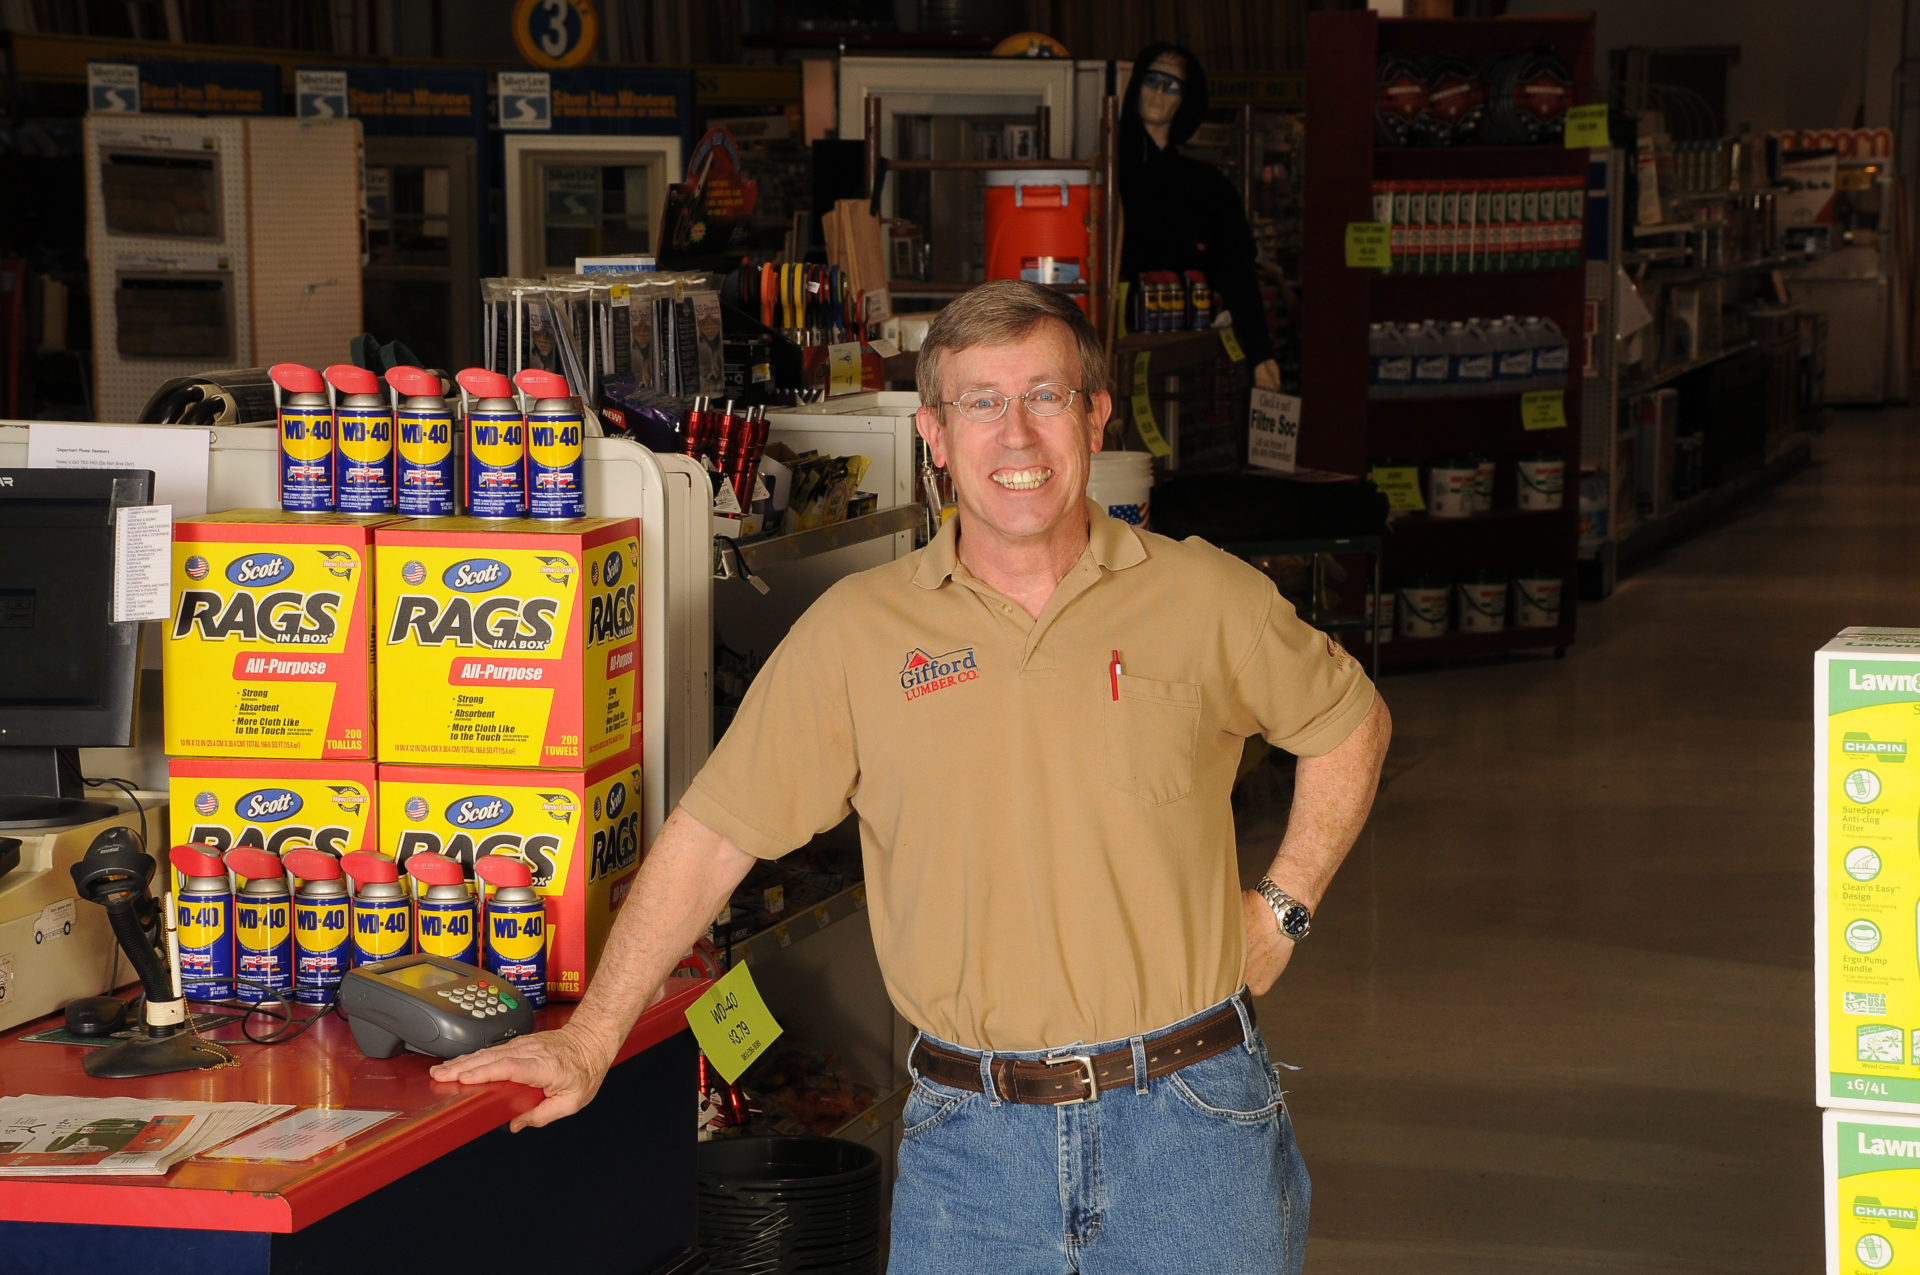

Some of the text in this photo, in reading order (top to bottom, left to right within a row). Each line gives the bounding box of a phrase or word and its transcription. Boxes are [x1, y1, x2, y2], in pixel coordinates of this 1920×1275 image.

[541, 0, 569, 57] 3
[141, 81, 262, 100] Silver Line Windows
[350, 88, 471, 106] Silver Line Windows
[552, 89, 677, 107] Silver Line Windows
[602, 408, 622, 424] NEW!
[284, 420, 331, 440] WD-40
[342, 421, 389, 442] WD-40
[401, 423, 448, 444] WD-40
[1278, 414, 1298, 437] Soc
[475, 426, 522, 446] WD-40
[532, 427, 579, 447] WD-40
[237, 557, 284, 583] Scott
[454, 563, 501, 588] Scott
[606, 557, 621, 583] Scott
[172, 590, 344, 641] RAGS
[388, 595, 559, 646] RAGS
[587, 584, 636, 648] RAGS
[277, 634, 327, 644] IN A BOX
[493, 640, 544, 650] IN A BOX
[245, 658, 328, 677] All-Purpose
[610, 652, 633, 671] All-Purpose
[461, 663, 544, 682] All-Purpose
[900, 651, 977, 690] Gifford
[242, 689, 268, 698] Strong
[905, 670, 980, 701] LUMBER CO.
[240, 703, 280, 712] Absorbent
[457, 695, 483, 704] Strong
[454, 709, 495, 718] Absorbent
[237, 717, 300, 727] More Cloth Like
[452, 724, 516, 734] More Cloth Like
[235, 727, 286, 737] to the Touch
[345, 729, 363, 739] 200
[450, 733, 501, 742] to the Touch
[561, 735, 579, 745] 200
[327, 740, 363, 750] TOALLAS
[544, 745, 579, 756] TOWELS
[1845, 743, 1904, 753] CHAPIN
[248, 794, 293, 818] Scott
[347, 796, 367, 804] Look!
[456, 800, 502, 825] Scott
[1842, 815, 1880, 825] Anti-clog
[1843, 824, 1865, 832] Filter
[589, 812, 638, 884] RAGS
[532, 877, 547, 886] OX
[1842, 883, 1895, 895] Clean'n Easy
[1842, 892, 1871, 902] Design
[238, 908, 286, 929] WD-40
[297, 910, 345, 931] WD-40
[357, 912, 406, 934] WD-40
[421, 915, 469, 936] WD-40
[494, 916, 542, 939] WD-40
[190, 953, 196, 963] 2
[255, 955, 262, 964] 2
[315, 958, 322, 966] 2
[1843, 955, 1888, 966] Ergo Pump
[515, 964, 522, 974] 2
[562, 972, 579, 981] 200
[1843, 964, 1873, 973] Handle
[547, 982, 579, 992] TOWELS
[710, 992, 739, 1025] WD-40
[1868, 997, 1886, 1008] USA
[728, 1021, 751, 1046] $3.79
[1879, 1063, 1900, 1071] Control
[1846, 1078, 1889, 1096] 1G/4L
[1855, 1206, 1917, 1219] CHAPIN
